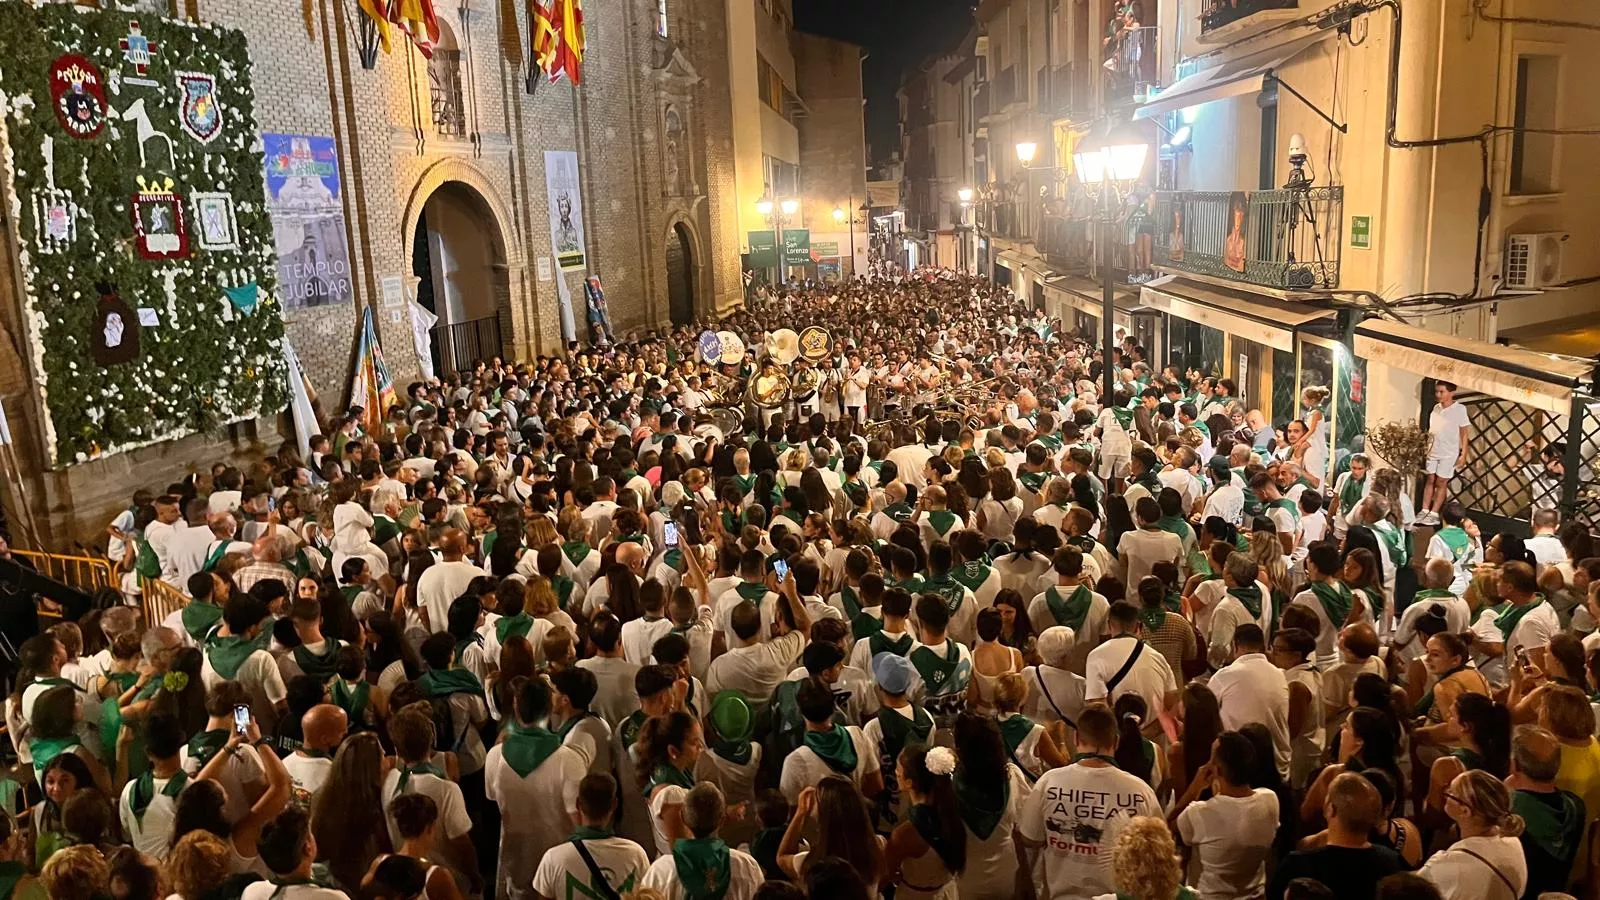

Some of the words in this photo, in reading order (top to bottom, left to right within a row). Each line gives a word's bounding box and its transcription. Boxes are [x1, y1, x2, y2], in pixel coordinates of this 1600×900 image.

[283, 260, 344, 279] TEMPLO
[286, 279, 348, 299] JUBILAR
[1046, 786, 1111, 806] SHIFT
[1116, 793, 1145, 808] UP
[1053, 803, 1069, 816] A
